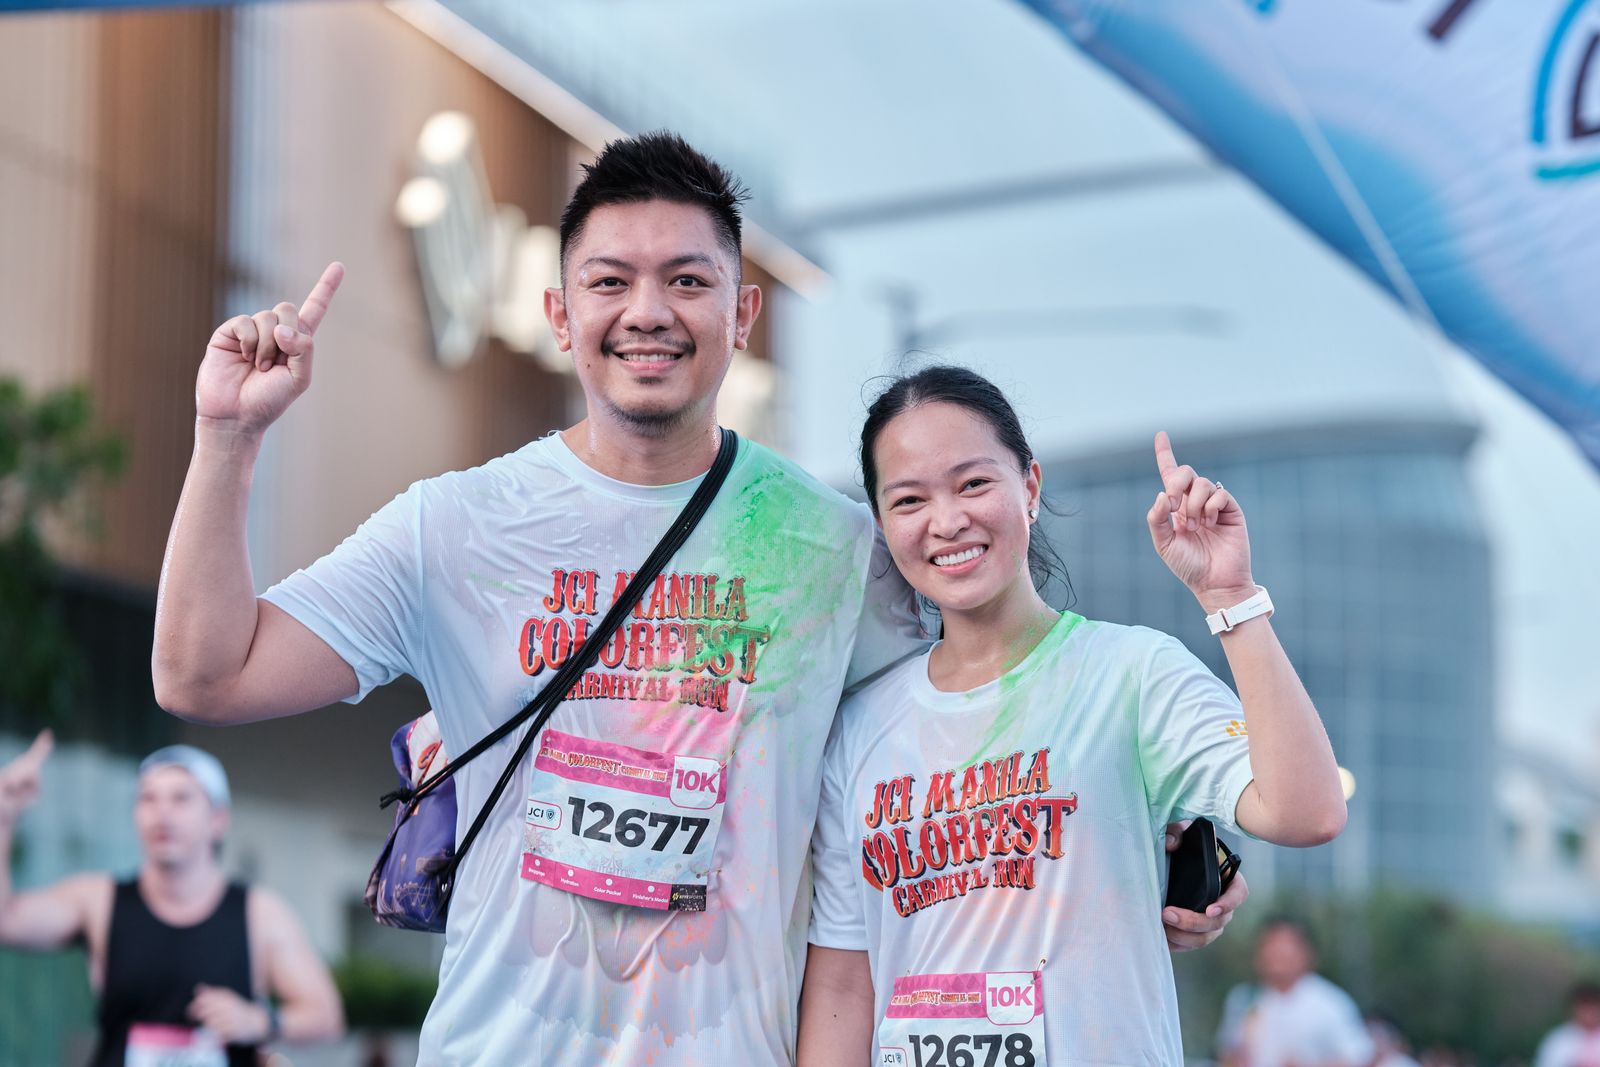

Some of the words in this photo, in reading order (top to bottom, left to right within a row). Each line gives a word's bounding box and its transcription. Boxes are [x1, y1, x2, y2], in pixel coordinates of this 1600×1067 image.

[543, 568, 600, 615] JCI
[565, 671, 674, 702] ARNIVAL
[679, 677, 731, 712] RUN
[675, 768, 719, 793] 10K
[864, 774, 916, 829] JCI
[922, 746, 1052, 818] MANILA
[528, 807, 544, 818] JCI
[568, 796, 710, 855] 12677
[862, 792, 1078, 892] COLORFEST
[892, 864, 989, 918] CARNIVL
[992, 855, 1036, 890] RUN
[987, 986, 1033, 1007] 10K
[884, 1054, 895, 1063] JCI
[909, 1033, 1035, 1067] 12678
